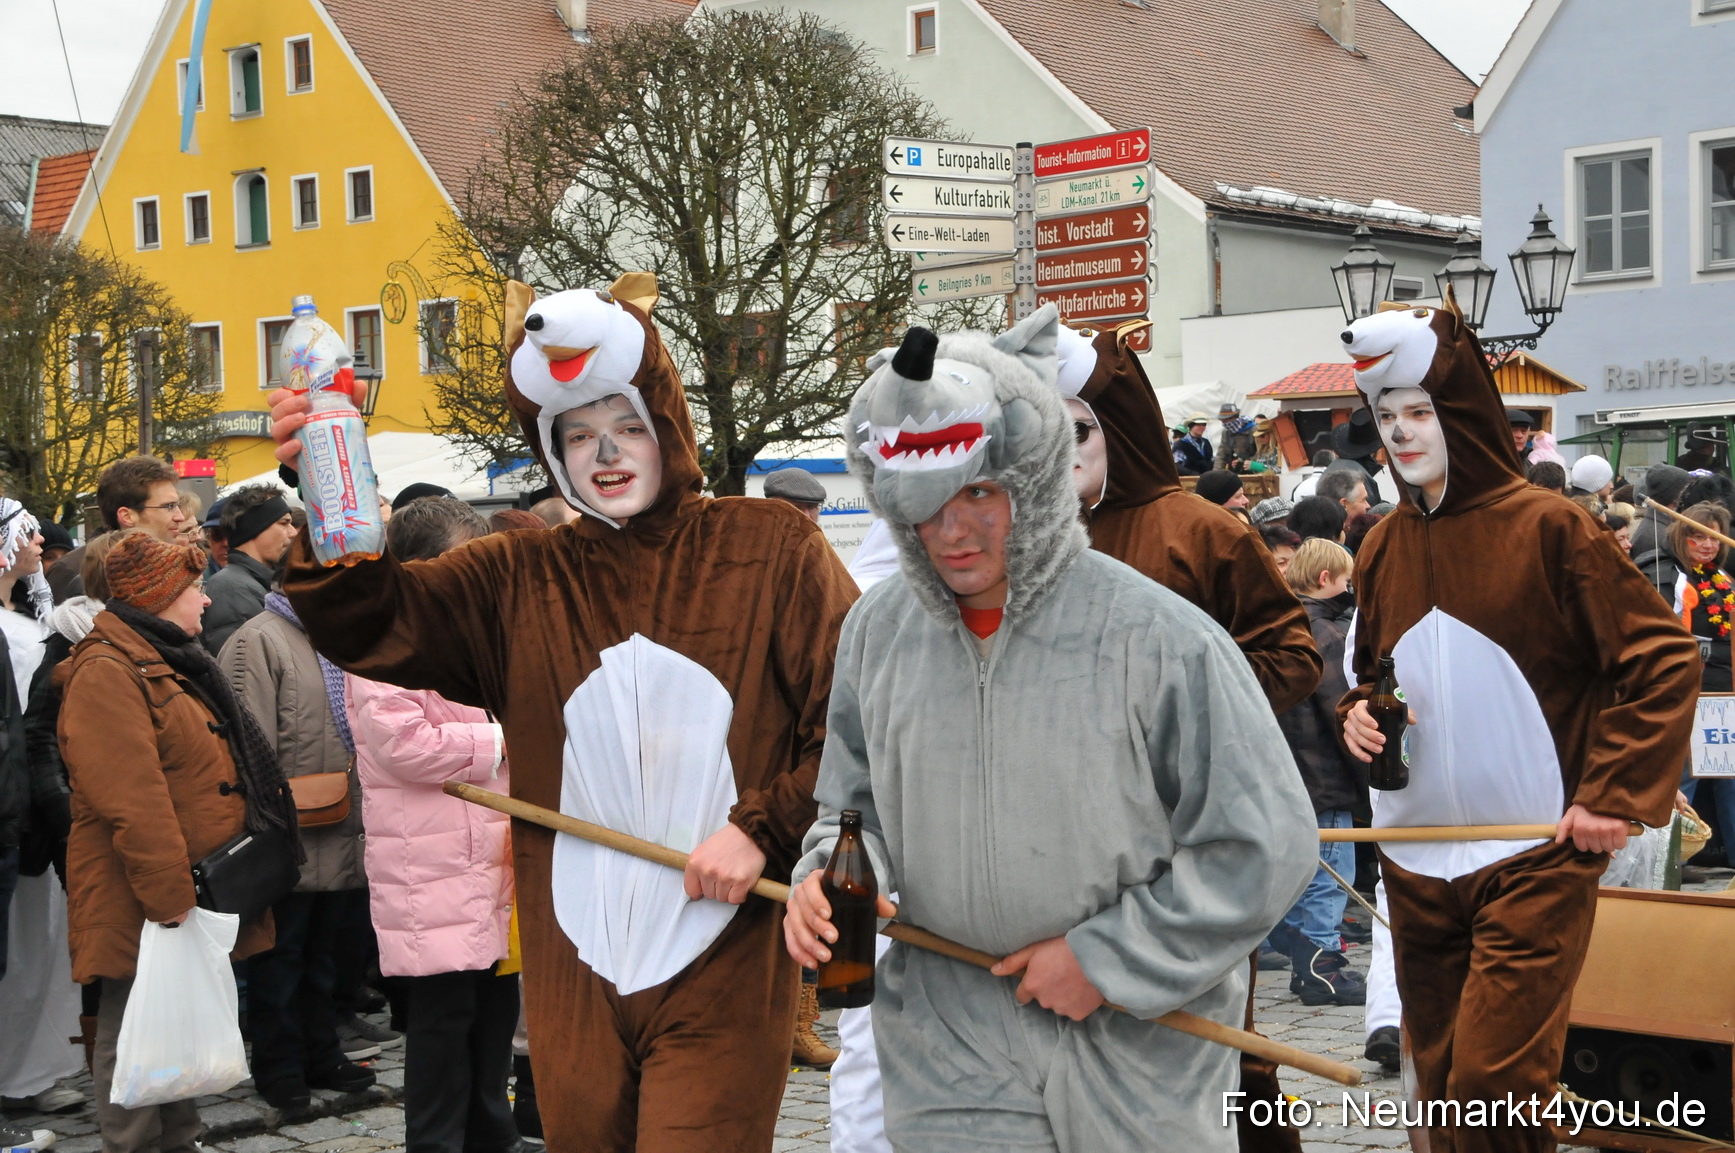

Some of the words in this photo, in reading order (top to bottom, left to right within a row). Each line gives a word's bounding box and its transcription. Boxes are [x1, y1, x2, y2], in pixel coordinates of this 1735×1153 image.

[909, 149, 919, 164] P
[937, 148, 1011, 173] Europahalle
[1037, 144, 1112, 169] Tourist-Information
[934, 186, 1011, 209] Kulturfabrik
[1069, 178, 1102, 193] Neumarkt
[1061, 193, 1098, 209] LDM-Kanal
[1109, 190, 1120, 201] km
[908, 226, 990, 242] Eine-Welt-Laden
[1037, 225, 1061, 245] hist.
[1066, 217, 1114, 241] Vorstadt
[1037, 257, 1122, 281] Heimatmuseum
[938, 276, 972, 292] Beilngries
[974, 274, 980, 287] 9
[981, 273, 992, 286] km
[1038, 288, 1126, 317] Sdtpfarrkirche
[334, 426, 347, 461] DRINK
[308, 427, 346, 532] BOOSTER
[341, 464, 357, 509] ENERGY
